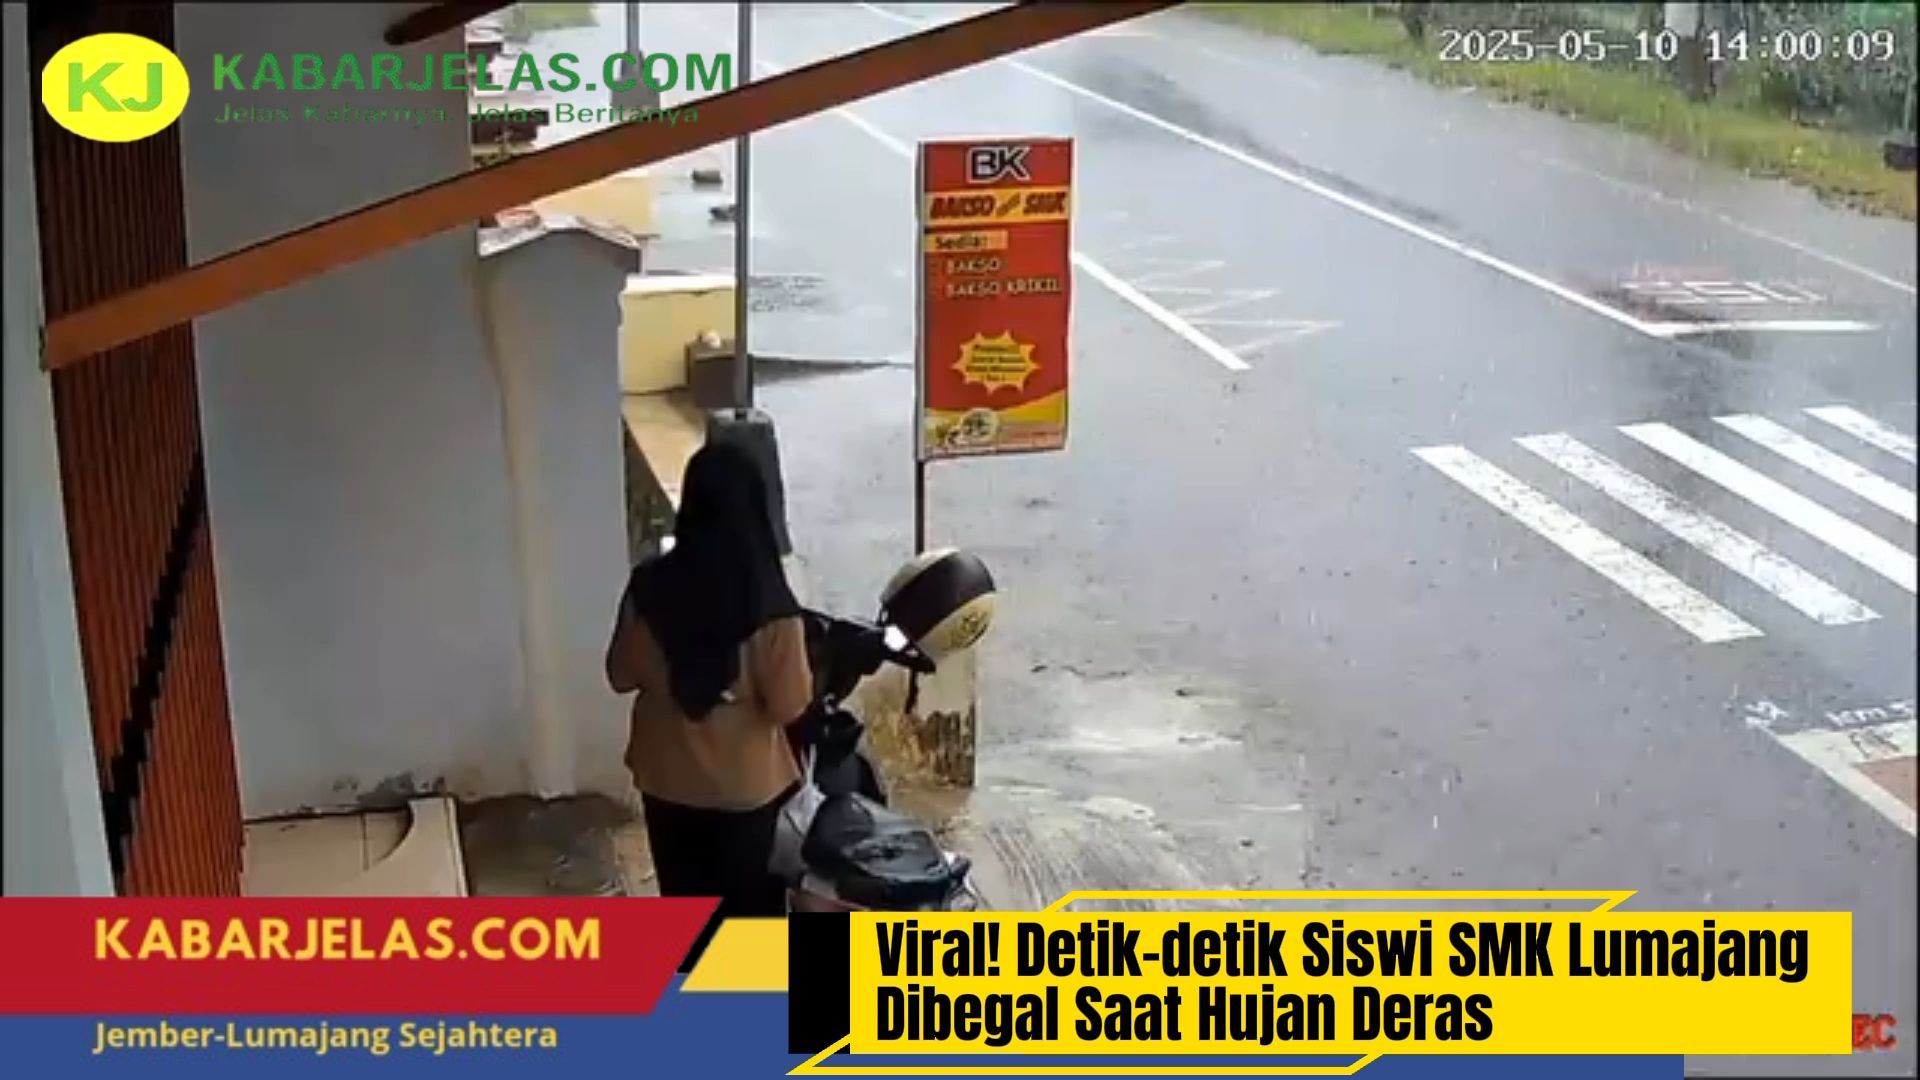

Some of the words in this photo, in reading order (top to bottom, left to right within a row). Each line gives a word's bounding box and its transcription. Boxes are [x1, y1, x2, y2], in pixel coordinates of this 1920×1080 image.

[967, 147, 1031, 184] BK
[946, 257, 1001, 274] BAKSO
[946, 281, 1001, 299] BAKSO
